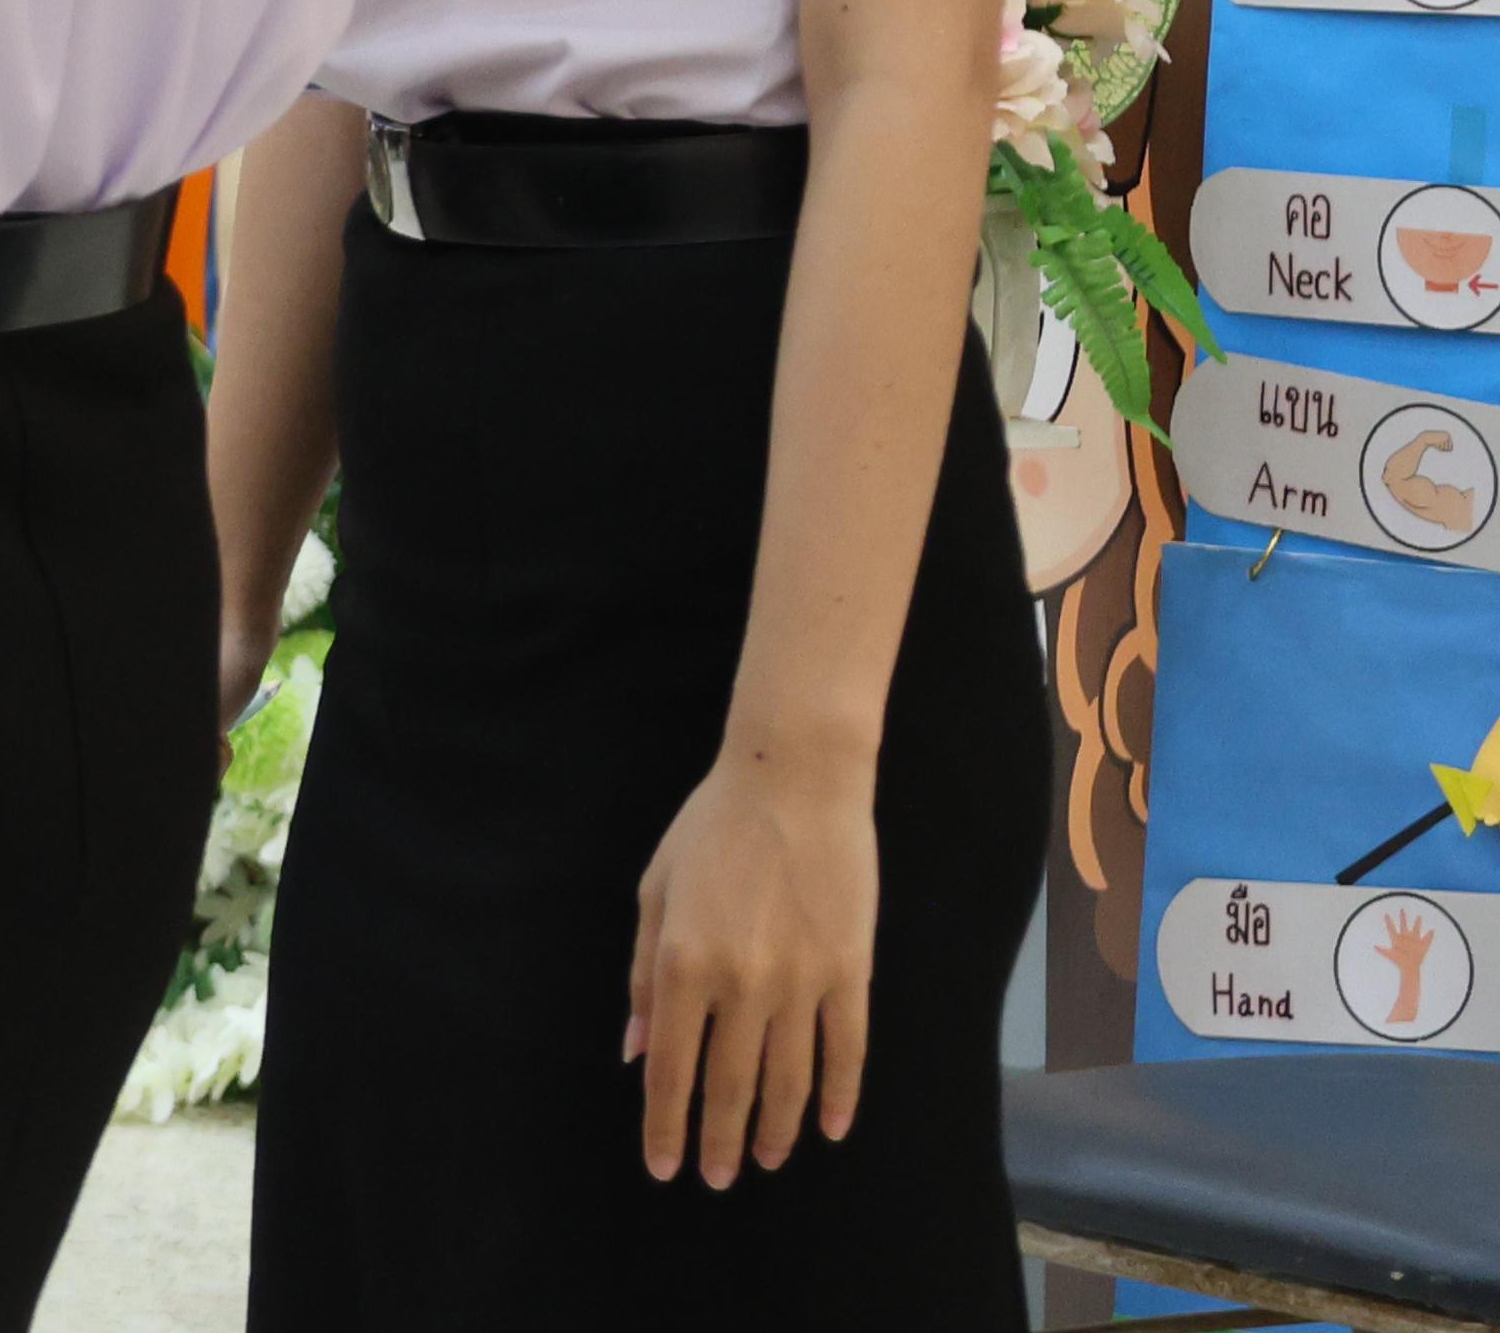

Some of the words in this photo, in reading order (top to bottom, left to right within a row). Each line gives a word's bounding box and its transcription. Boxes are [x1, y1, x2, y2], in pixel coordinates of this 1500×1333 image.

[1286, 194, 1331, 239] คอ
[1268, 252, 1353, 302] Neck
[1259, 380, 1339, 438] แขน
[1248, 461, 1327, 516] Arm
[1226, 883, 1271, 946] มือ
[1212, 972, 1294, 1020] Hand
